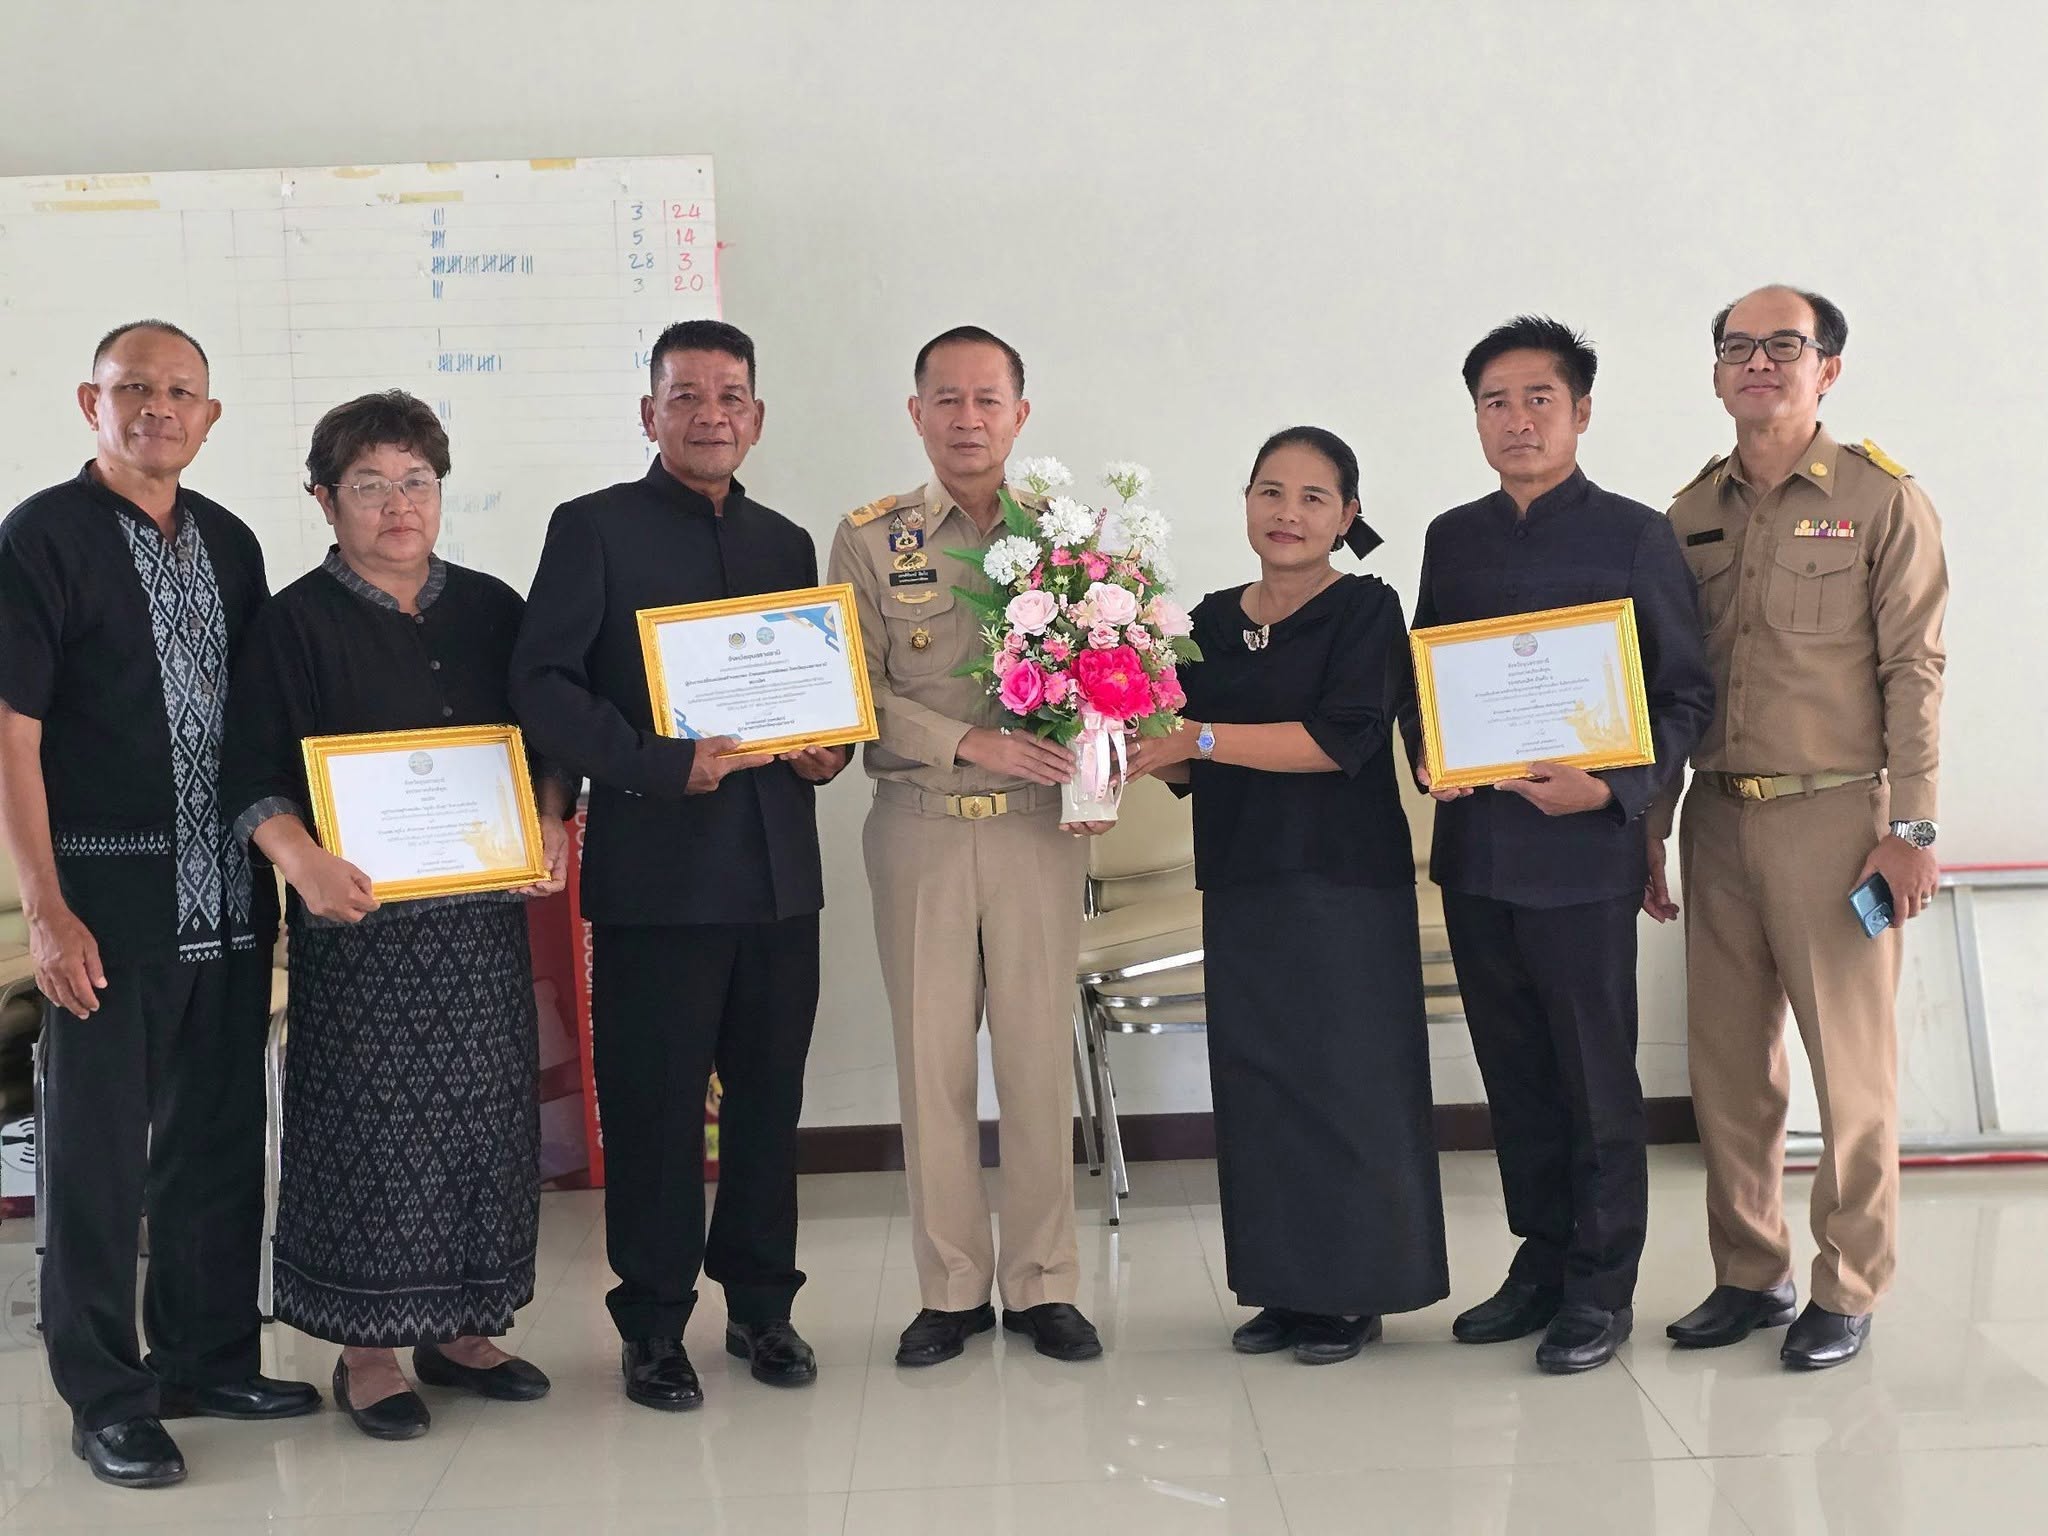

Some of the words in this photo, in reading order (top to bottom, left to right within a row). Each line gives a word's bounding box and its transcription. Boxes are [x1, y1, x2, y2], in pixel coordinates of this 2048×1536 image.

[630, 204, 644, 221] 3
[671, 203, 702, 220] 24
[632, 228, 645, 246] 5
[676, 228, 696, 245] 14
[628, 252, 655, 270] 28
[678, 252, 693, 270] 3
[632, 277, 645, 294] 3
[673, 275, 704, 292] 20
